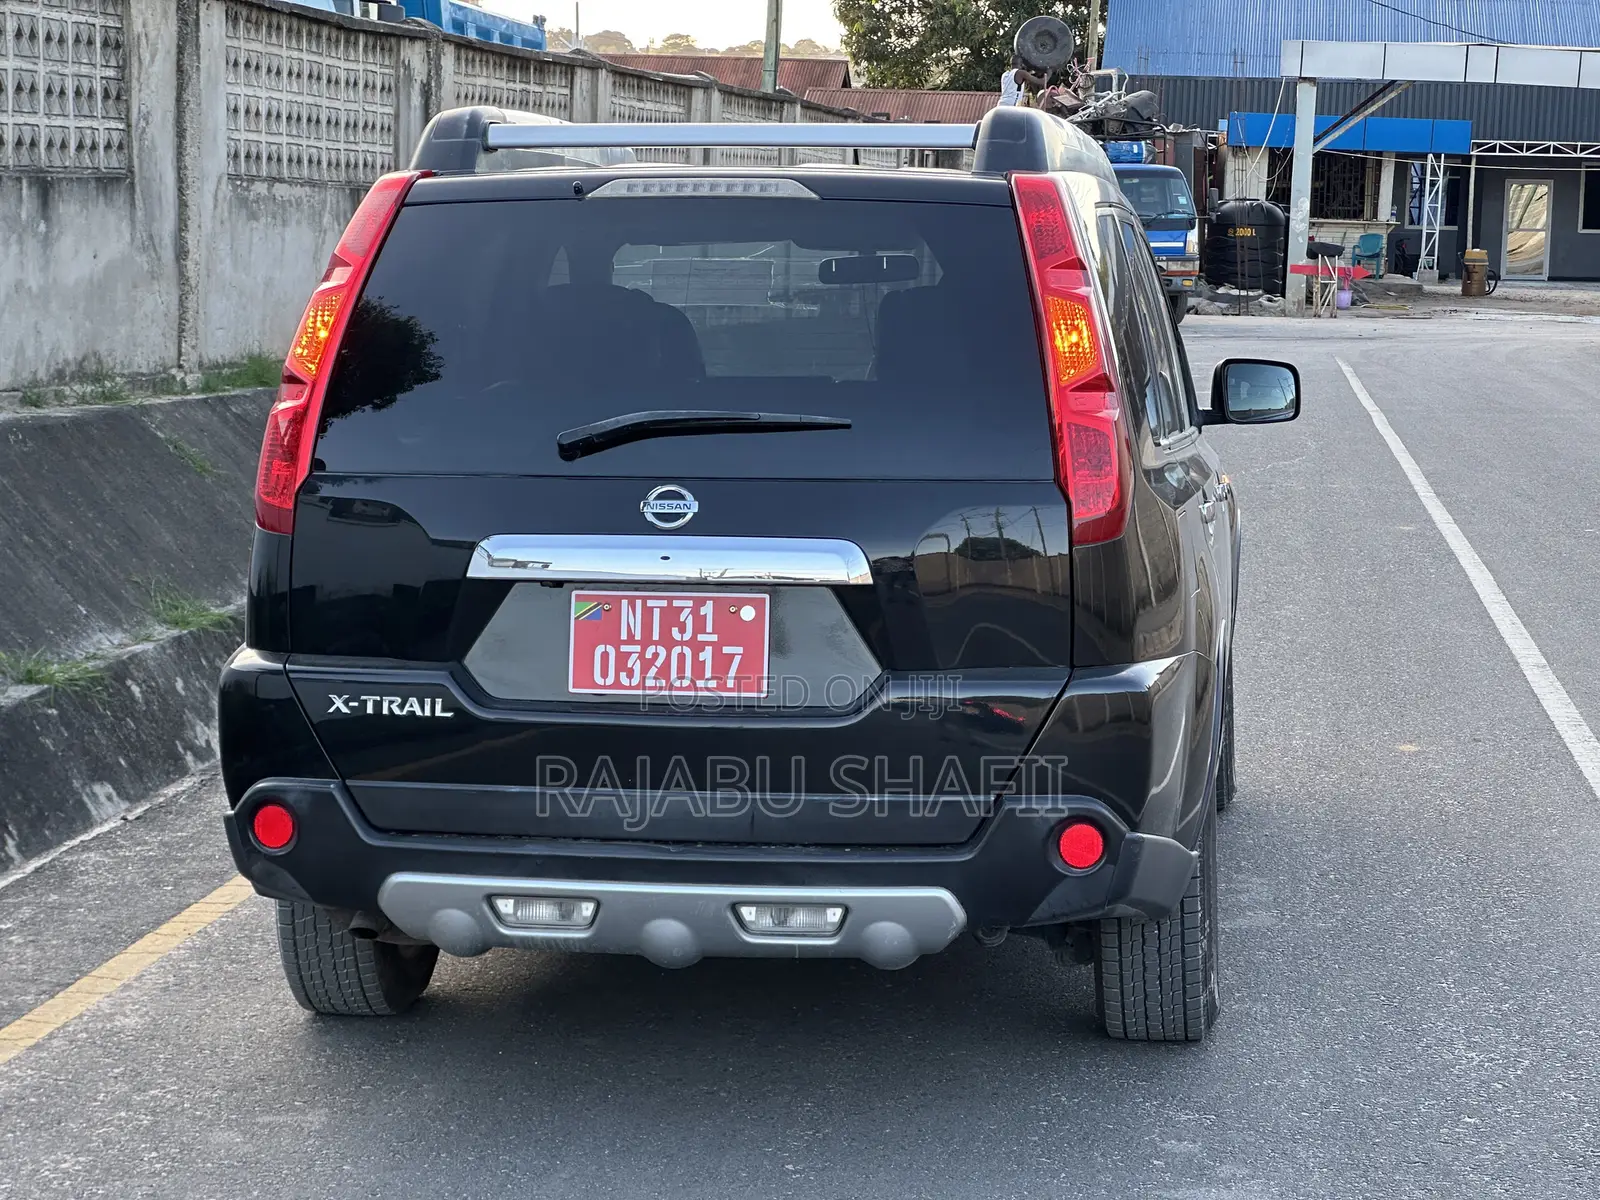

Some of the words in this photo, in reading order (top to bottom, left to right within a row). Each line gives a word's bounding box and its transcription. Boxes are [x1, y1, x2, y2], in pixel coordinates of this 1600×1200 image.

[646, 503, 692, 511] NISSAN
[620, 599, 718, 641] NT31
[593, 644, 744, 688] 032017
[327, 694, 455, 717] X-TRAIL
